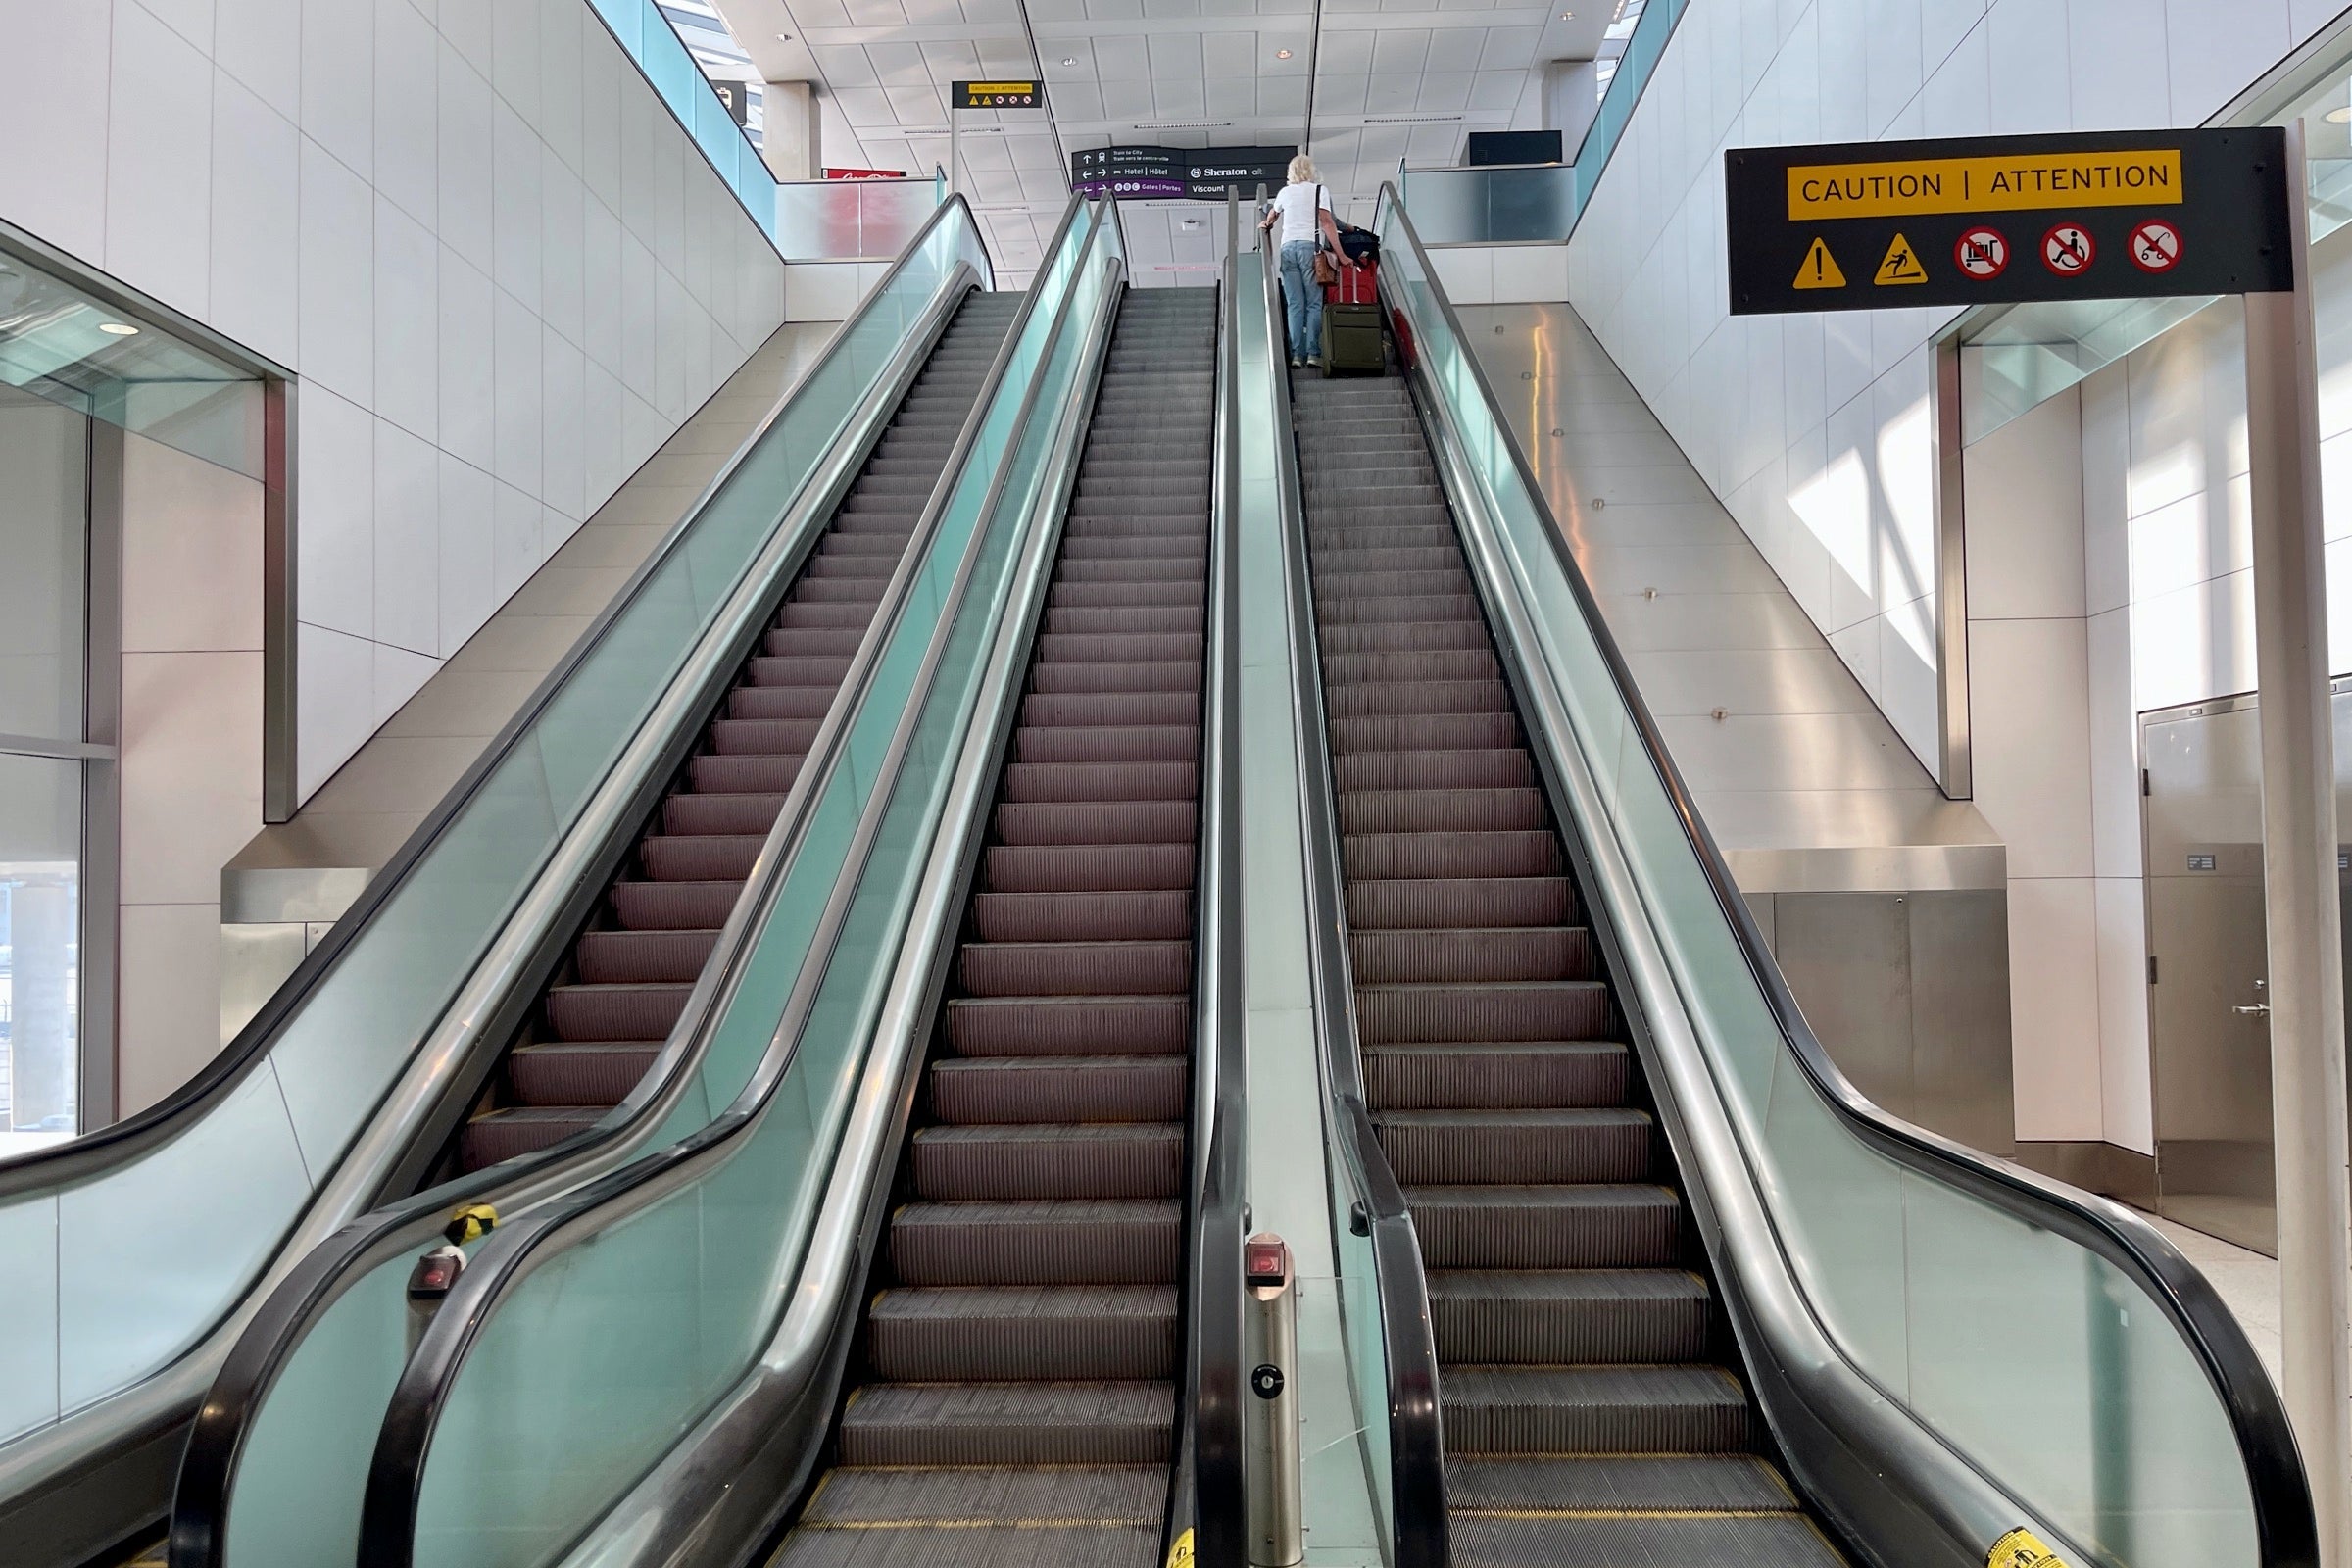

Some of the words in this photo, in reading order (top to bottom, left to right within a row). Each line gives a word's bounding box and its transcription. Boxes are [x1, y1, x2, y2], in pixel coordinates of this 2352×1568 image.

[1203, 168, 1248, 176] Sheraton
[1801, 173, 1942, 203] CAUTION
[1990, 164, 2169, 194] ATTENTION
[1192, 184, 1224, 193] Viscount
